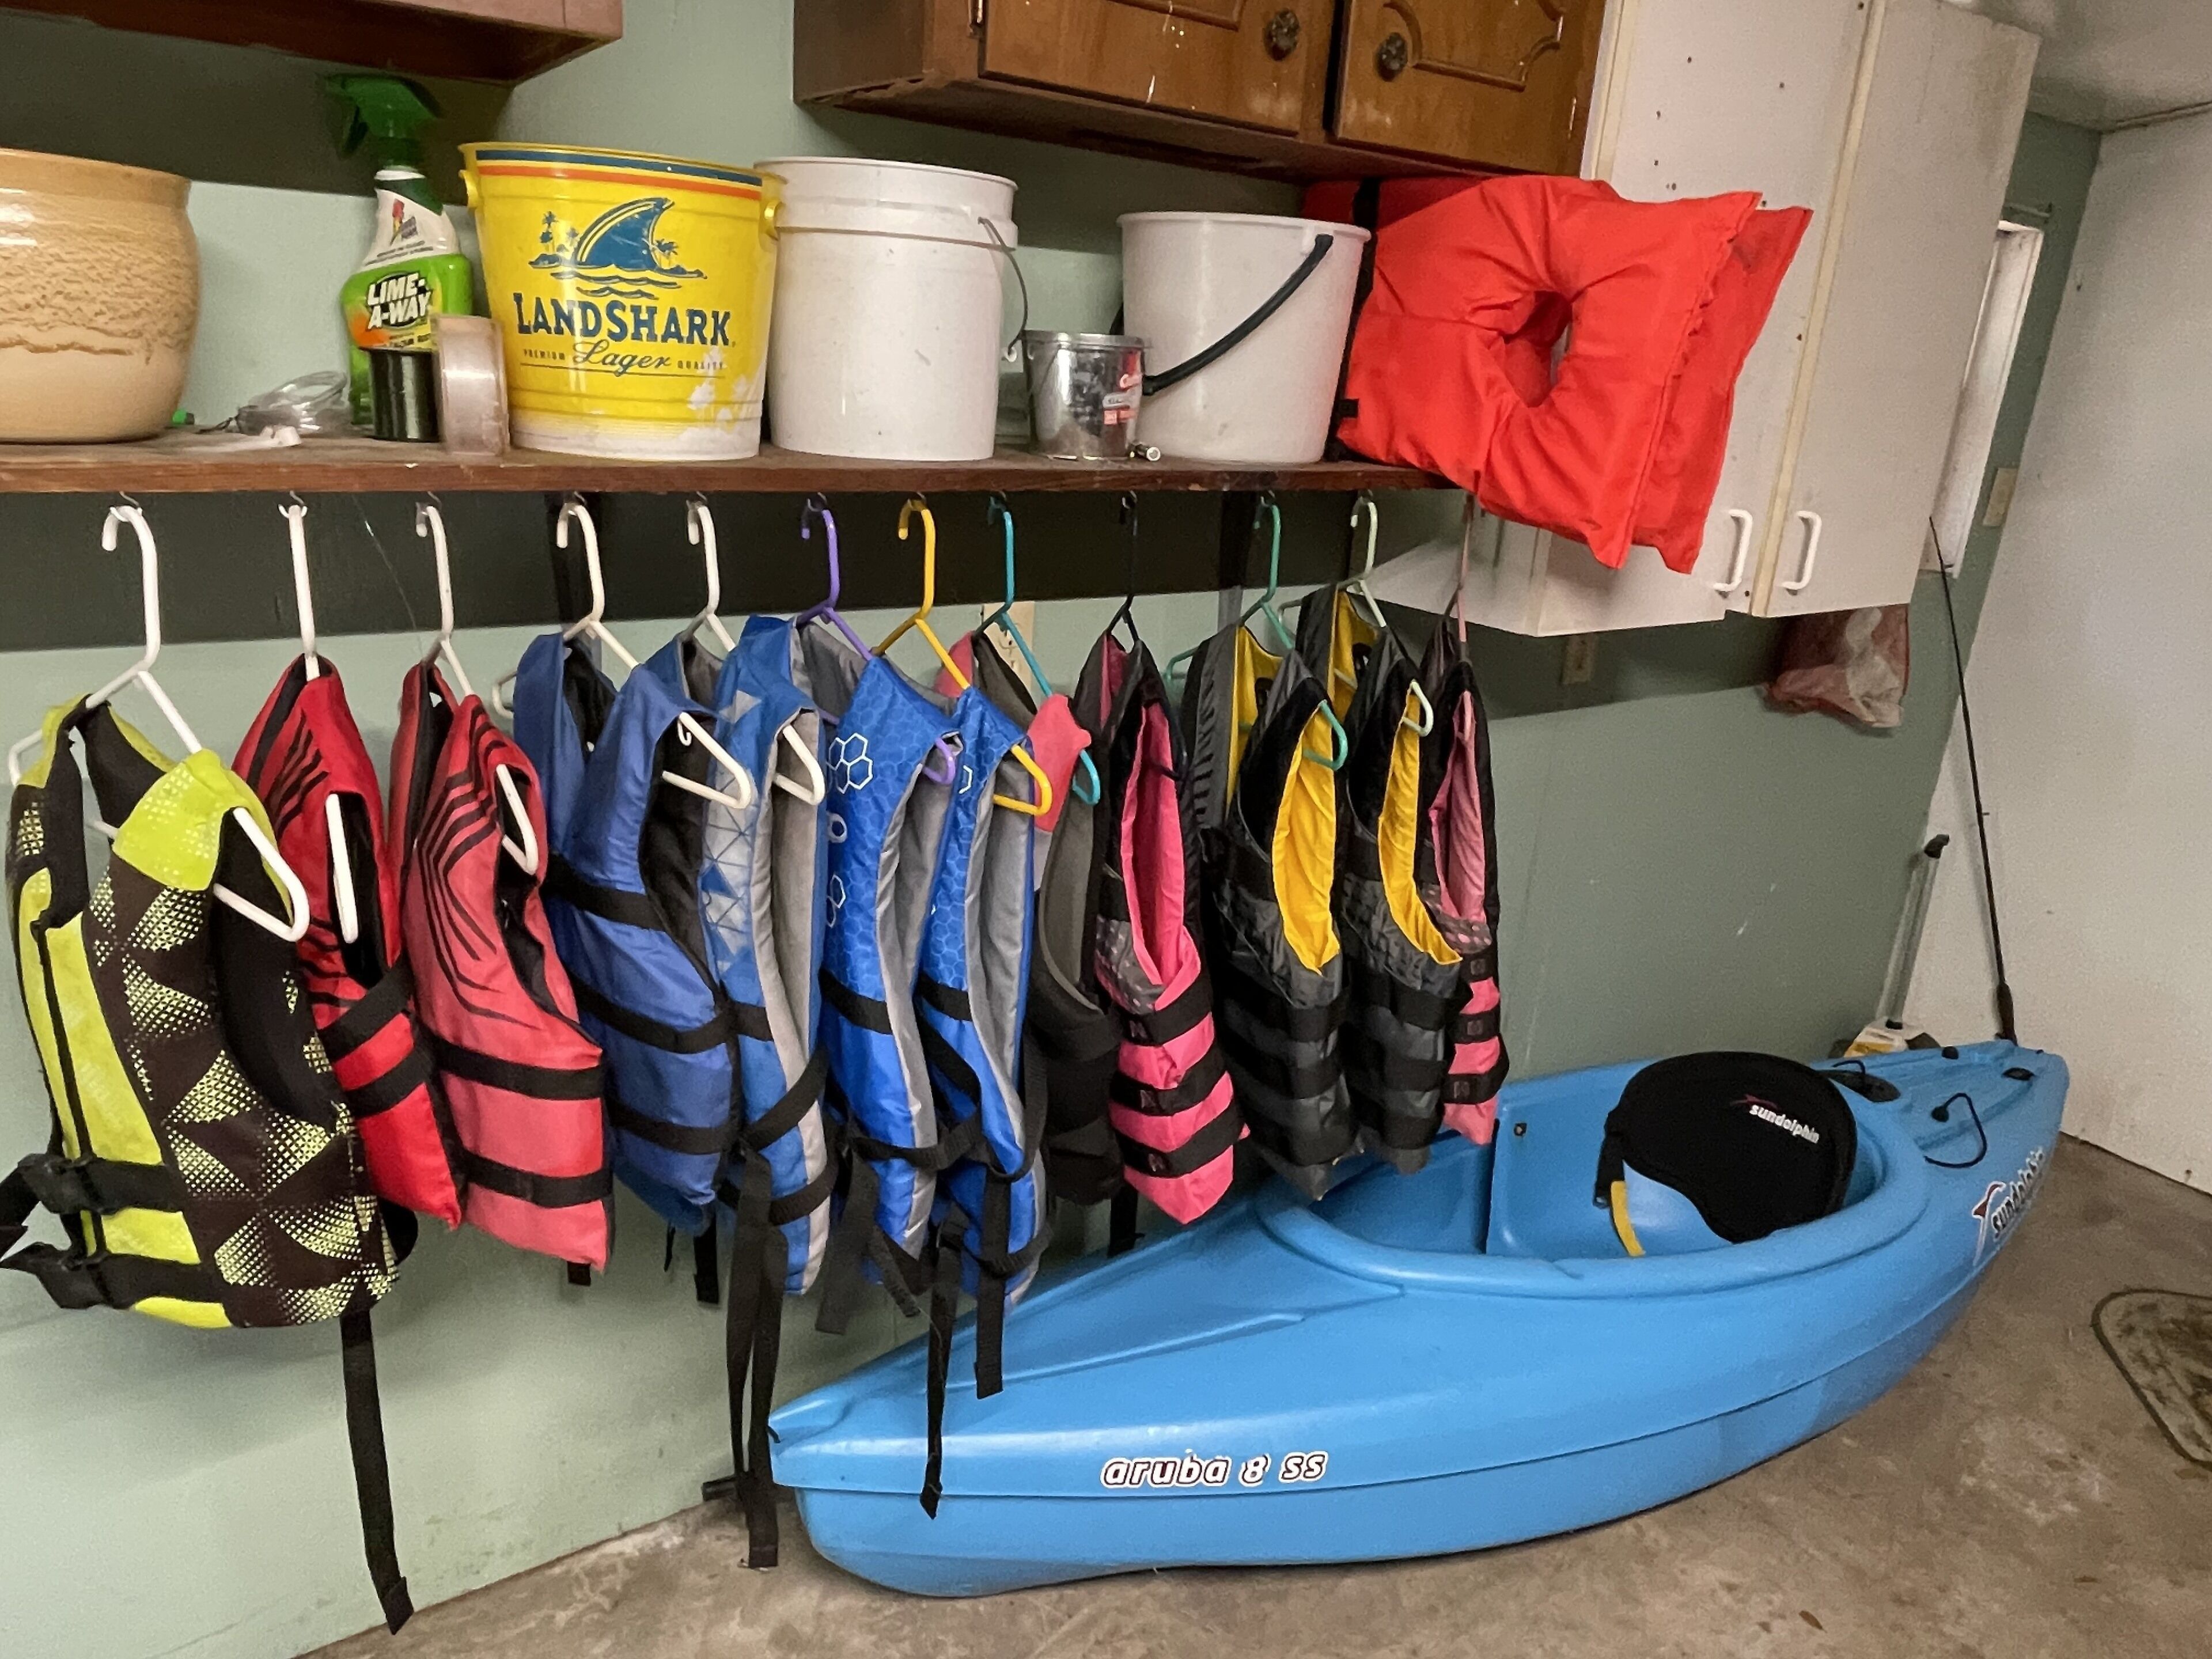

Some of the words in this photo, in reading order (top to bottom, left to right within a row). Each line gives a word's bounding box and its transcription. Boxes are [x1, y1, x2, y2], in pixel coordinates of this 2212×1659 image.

[368, 272, 426, 306] LIME-
[367, 291, 431, 329] A-WAY
[513, 293, 730, 346] LANDSHARK
[573, 339, 672, 377] Lager
[1749, 1104, 1820, 1143] sundolphin
[1100, 1448, 1232, 1488] aruba
[1238, 1453, 1272, 1487] 8
